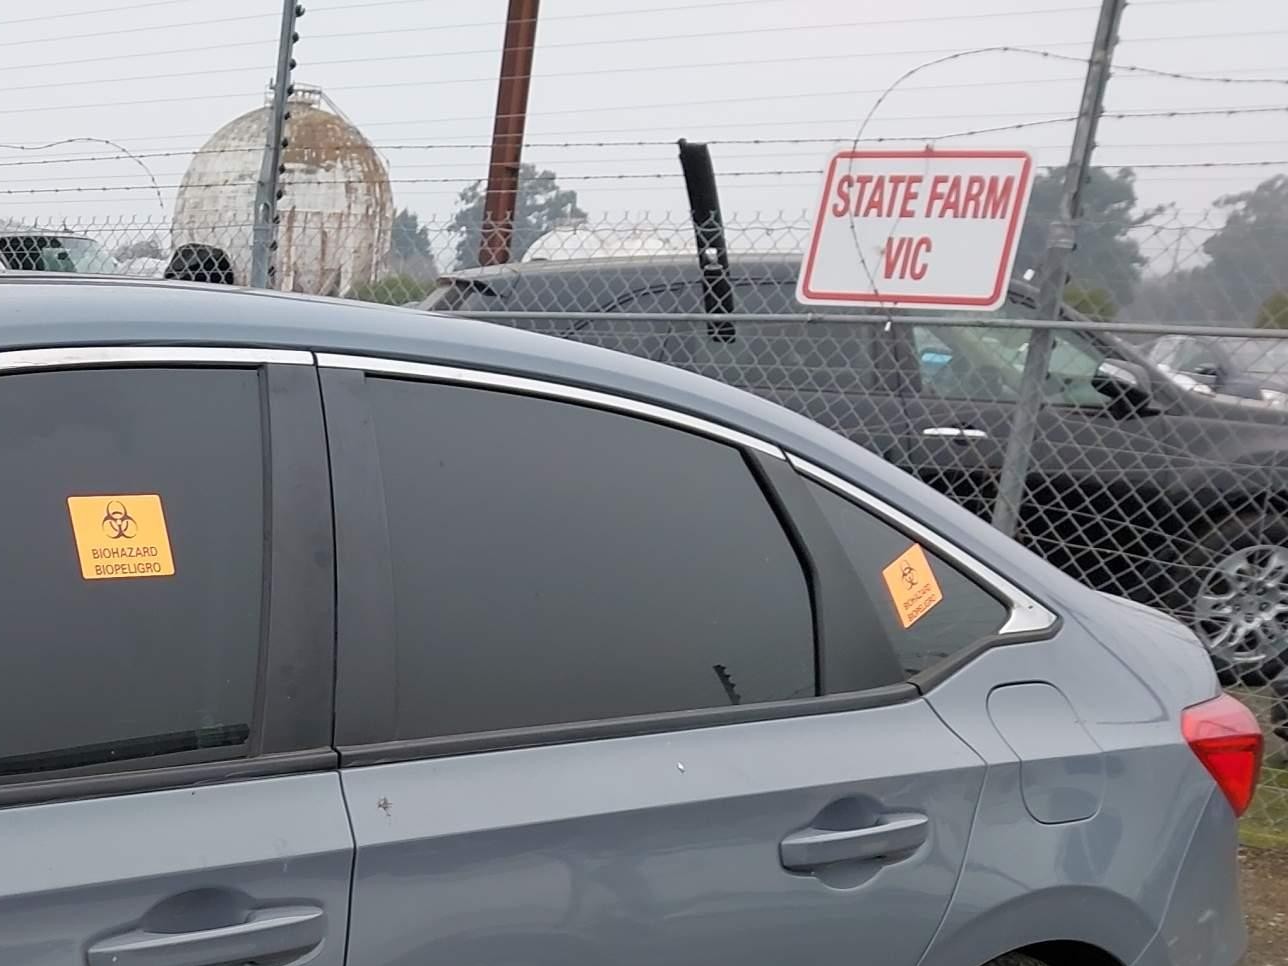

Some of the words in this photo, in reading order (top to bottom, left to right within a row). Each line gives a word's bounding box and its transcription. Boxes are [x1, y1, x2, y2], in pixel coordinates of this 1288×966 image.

[832, 175, 923, 218] STATE
[924, 175, 1015, 219] FARM
[883, 236, 932, 280] VIC
[92, 546, 158, 559] BIOHAZARD
[95, 562, 161, 575] BIOPELIGRO
